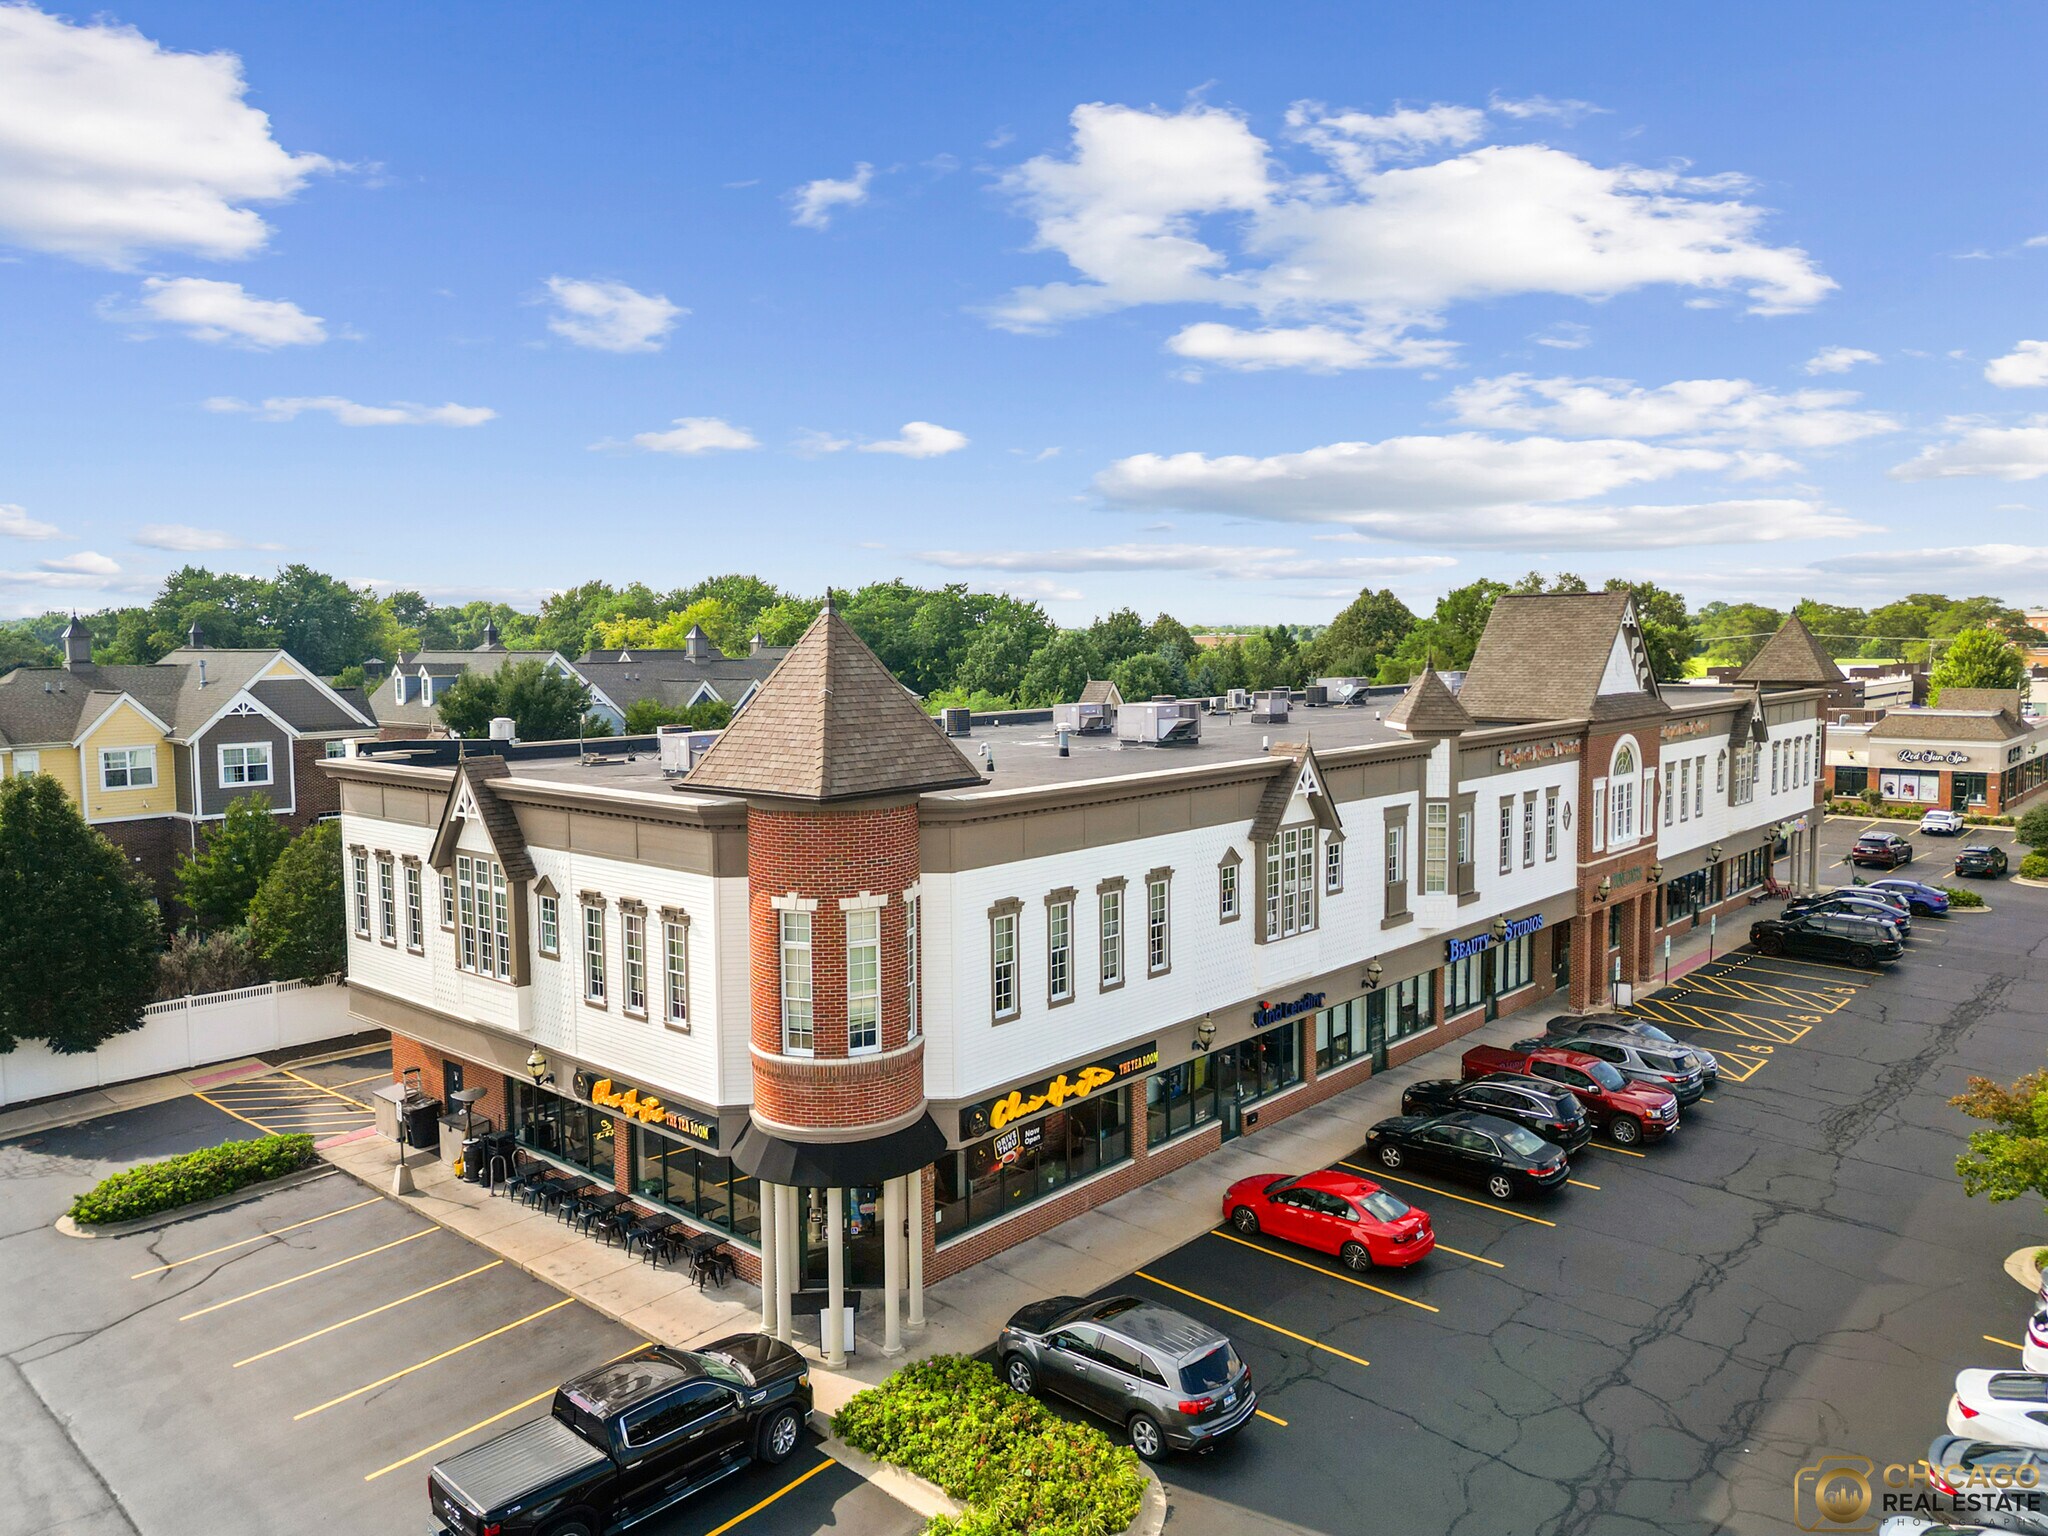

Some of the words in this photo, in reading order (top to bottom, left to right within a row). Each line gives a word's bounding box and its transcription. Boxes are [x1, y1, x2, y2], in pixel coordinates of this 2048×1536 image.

[1898, 750, 1920, 763] Red
[1921, 750, 1944, 763] Sun
[1945, 752, 1969, 765] Spa
[1448, 934, 1490, 962] BEAUTY
[1505, 914, 1544, 942] STUDIOS
[1254, 1002, 1282, 1028] Kind
[1119, 1062, 1131, 1075] THE
[1131, 1057, 1143, 1071] TEA
[1142, 1051, 1159, 1067] ROOM
[665, 1111, 677, 1129] THE
[678, 1116, 690, 1133] TEA
[690, 1120, 709, 1140] ROOM
[1025, 1127, 1040, 1138] Now
[996, 1130, 1017, 1149] DRIVE
[998, 1139, 1017, 1155] THRU
[1024, 1134, 1041, 1146] Open
